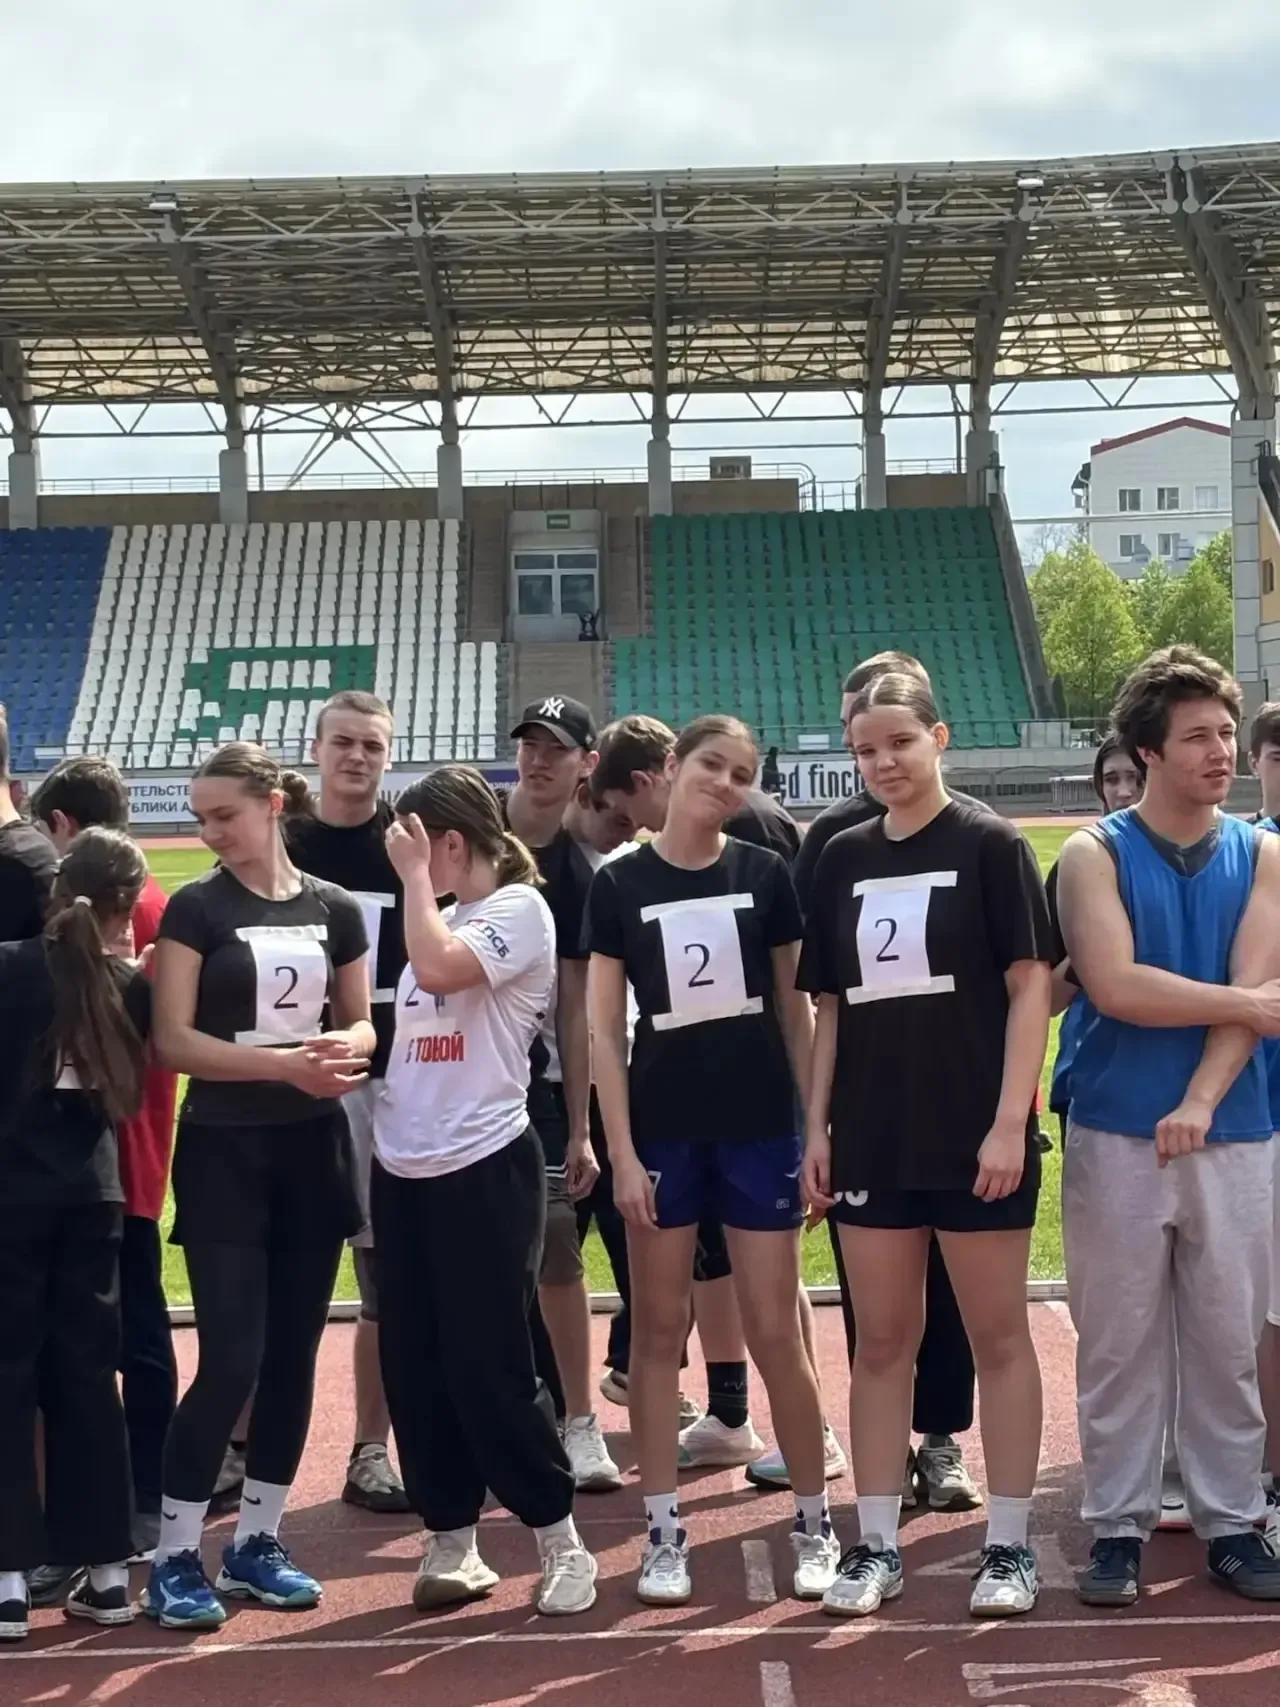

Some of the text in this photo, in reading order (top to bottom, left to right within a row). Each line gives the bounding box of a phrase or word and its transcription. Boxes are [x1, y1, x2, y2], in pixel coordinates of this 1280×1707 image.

[538, 697, 565, 719] NY
[779, 764, 800, 799] ed
[131, 802, 178, 813] БЛИКИ
[482, 925, 510, 958] ПСБ
[874, 918, 900, 962] 2
[684, 943, 714, 988] 2
[273, 966, 299, 1010] 2
